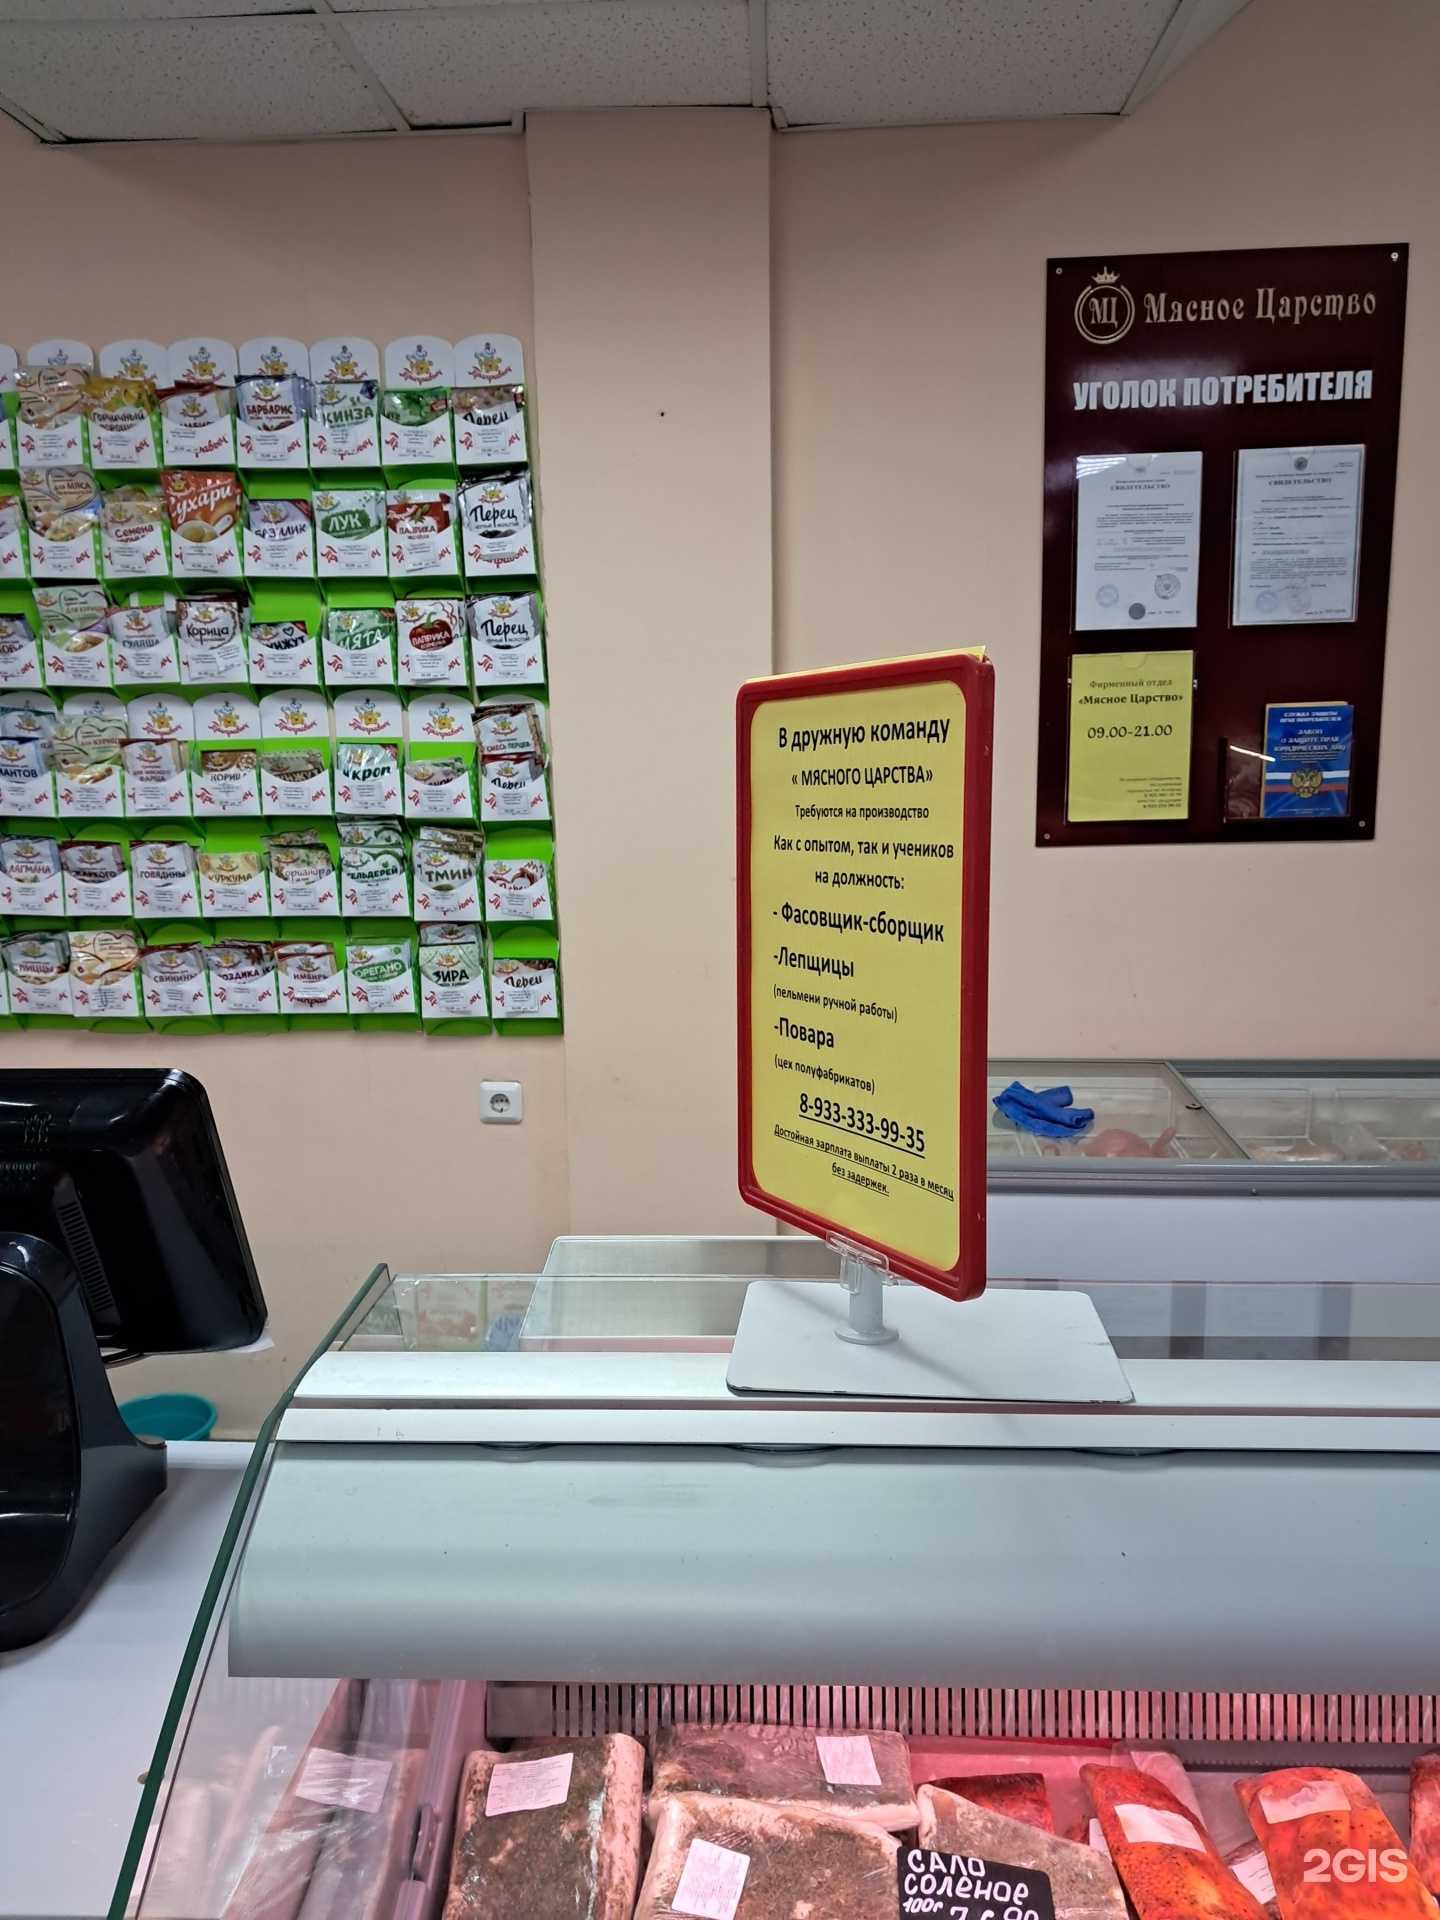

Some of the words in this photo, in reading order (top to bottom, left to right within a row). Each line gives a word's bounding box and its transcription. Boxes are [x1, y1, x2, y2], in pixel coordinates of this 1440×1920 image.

[1144, 292, 1245, 324] Мясное
[1256, 287, 1377, 325] Царство
[1073, 377, 1177, 412] УГОЛОК
[1183, 369, 1374, 408] ПОТРЕБИТЕЛЯ
[322, 406, 374, 426] КИНЗА
[328, 513, 362, 532] ЛУК
[469, 504, 518, 528] Перец
[186, 624, 230, 645] Корица
[481, 619, 529, 643] Перец
[1089, 679, 1145, 690] Фирменный
[1147, 678, 1173, 688] отдел
[1078, 694, 1127, 706] «Мясное
[1130, 692, 1184, 705] Царство»
[778, 727, 788, 748] В
[791, 724, 866, 752] дружную
[870, 717, 951, 744] команду
[1086, 724, 1173, 740] 09.00-21.00
[800, 767, 861, 786] МЯСНОГО
[864, 764, 934, 788] ЦАРСТВА»
[794, 804, 843, 820] Требуются
[845, 808, 857, 819] на
[859, 804, 929, 820] производство
[773, 834, 793, 852] Как
[796, 840, 802, 851] с
[804, 840, 855, 857] опытом,
[857, 840, 879, 855] так
[881, 843, 890, 855] и
[892, 842, 954, 860] учеников
[425, 867, 473, 882] ТМИН
[815, 870, 829, 884] на
[831, 869, 905, 890] должность:
[781, 901, 945, 943] Фасовщик-сборщик
[353, 961, 402, 977] ОРЕГАНО
[773, 946, 855, 980] -Лепщицы
[432, 968, 470, 983] ЗИРА
[773, 983, 821, 1005] (пельмени
[823, 996, 857, 1013] ручной
[859, 998, 898, 1024] работы)
[774, 1017, 835, 1050] -Повара
[774, 1054, 793, 1071] (цех
[794, 1058, 876, 1096] полуфабрикатов)
[799, 1092, 926, 1155] 8-933-333-99-35
[774, 1123, 814, 1148] Достойная
[816, 1137, 852, 1160] зарплата
[854, 1150, 890, 1175] выплаты
[899, 1168, 919, 1186] раза
[927, 1179, 955, 1200] месяц
[832, 1161, 846, 1178] без
[847, 1167, 890, 1194] задержек.
[907, 1849, 986, 1878] САЛО
[902, 1897, 944, 1914] 100г
